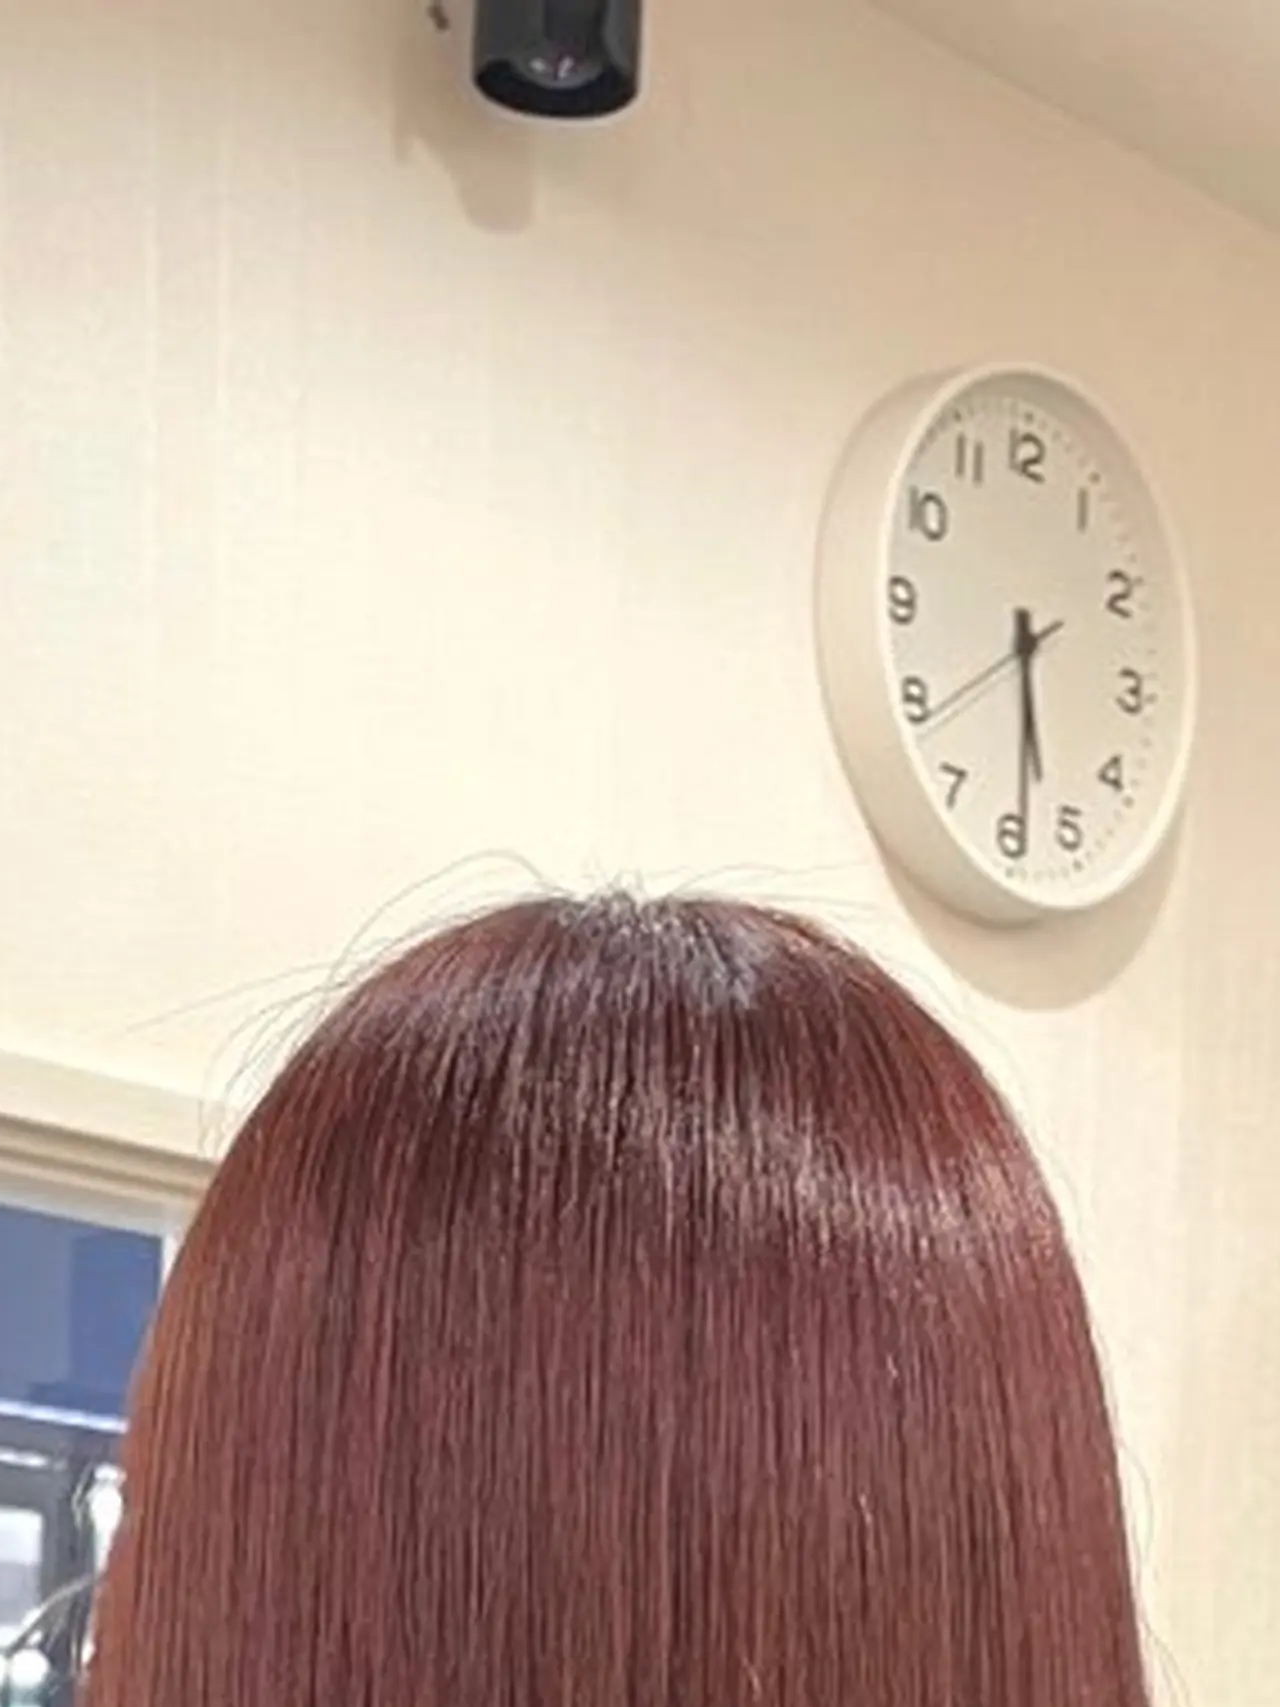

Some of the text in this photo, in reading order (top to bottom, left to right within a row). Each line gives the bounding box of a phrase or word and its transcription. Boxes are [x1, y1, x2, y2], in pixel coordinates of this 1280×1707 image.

[956, 432, 984, 487] 11
[1009, 429, 1046, 483] 12
[909, 486, 948, 542] 10
[1078, 486, 1088, 530] 1
[889, 576, 917, 625] 9
[1106, 569, 1133, 619] 2
[902, 677, 929, 723] 8
[1116, 669, 1144, 715] 3
[939, 763, 969, 809] 7
[1098, 754, 1125, 792] 4
[998, 814, 1027, 859] 6
[1056, 807, 1082, 852] 5
